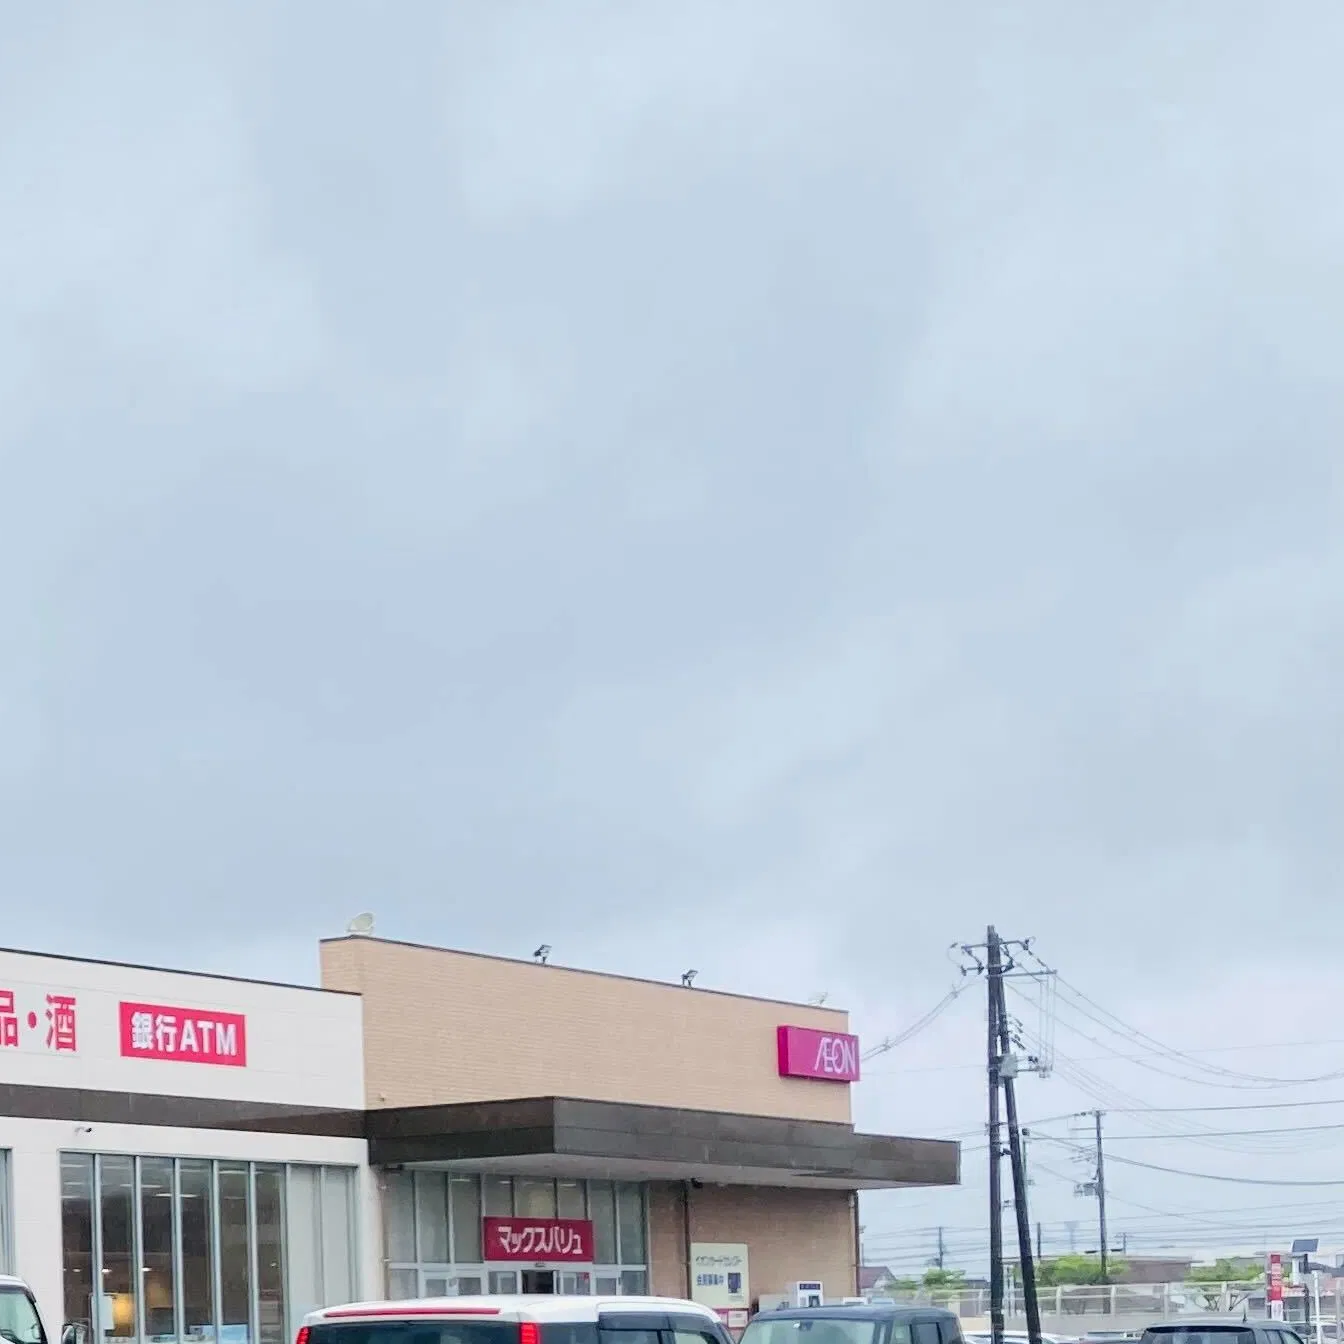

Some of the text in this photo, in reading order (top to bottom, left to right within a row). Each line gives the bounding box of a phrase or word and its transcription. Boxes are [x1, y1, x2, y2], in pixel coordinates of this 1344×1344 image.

[131, 1011, 237, 1056] 銀行ATM
[497, 1225, 583, 1254] マックスバリュ
